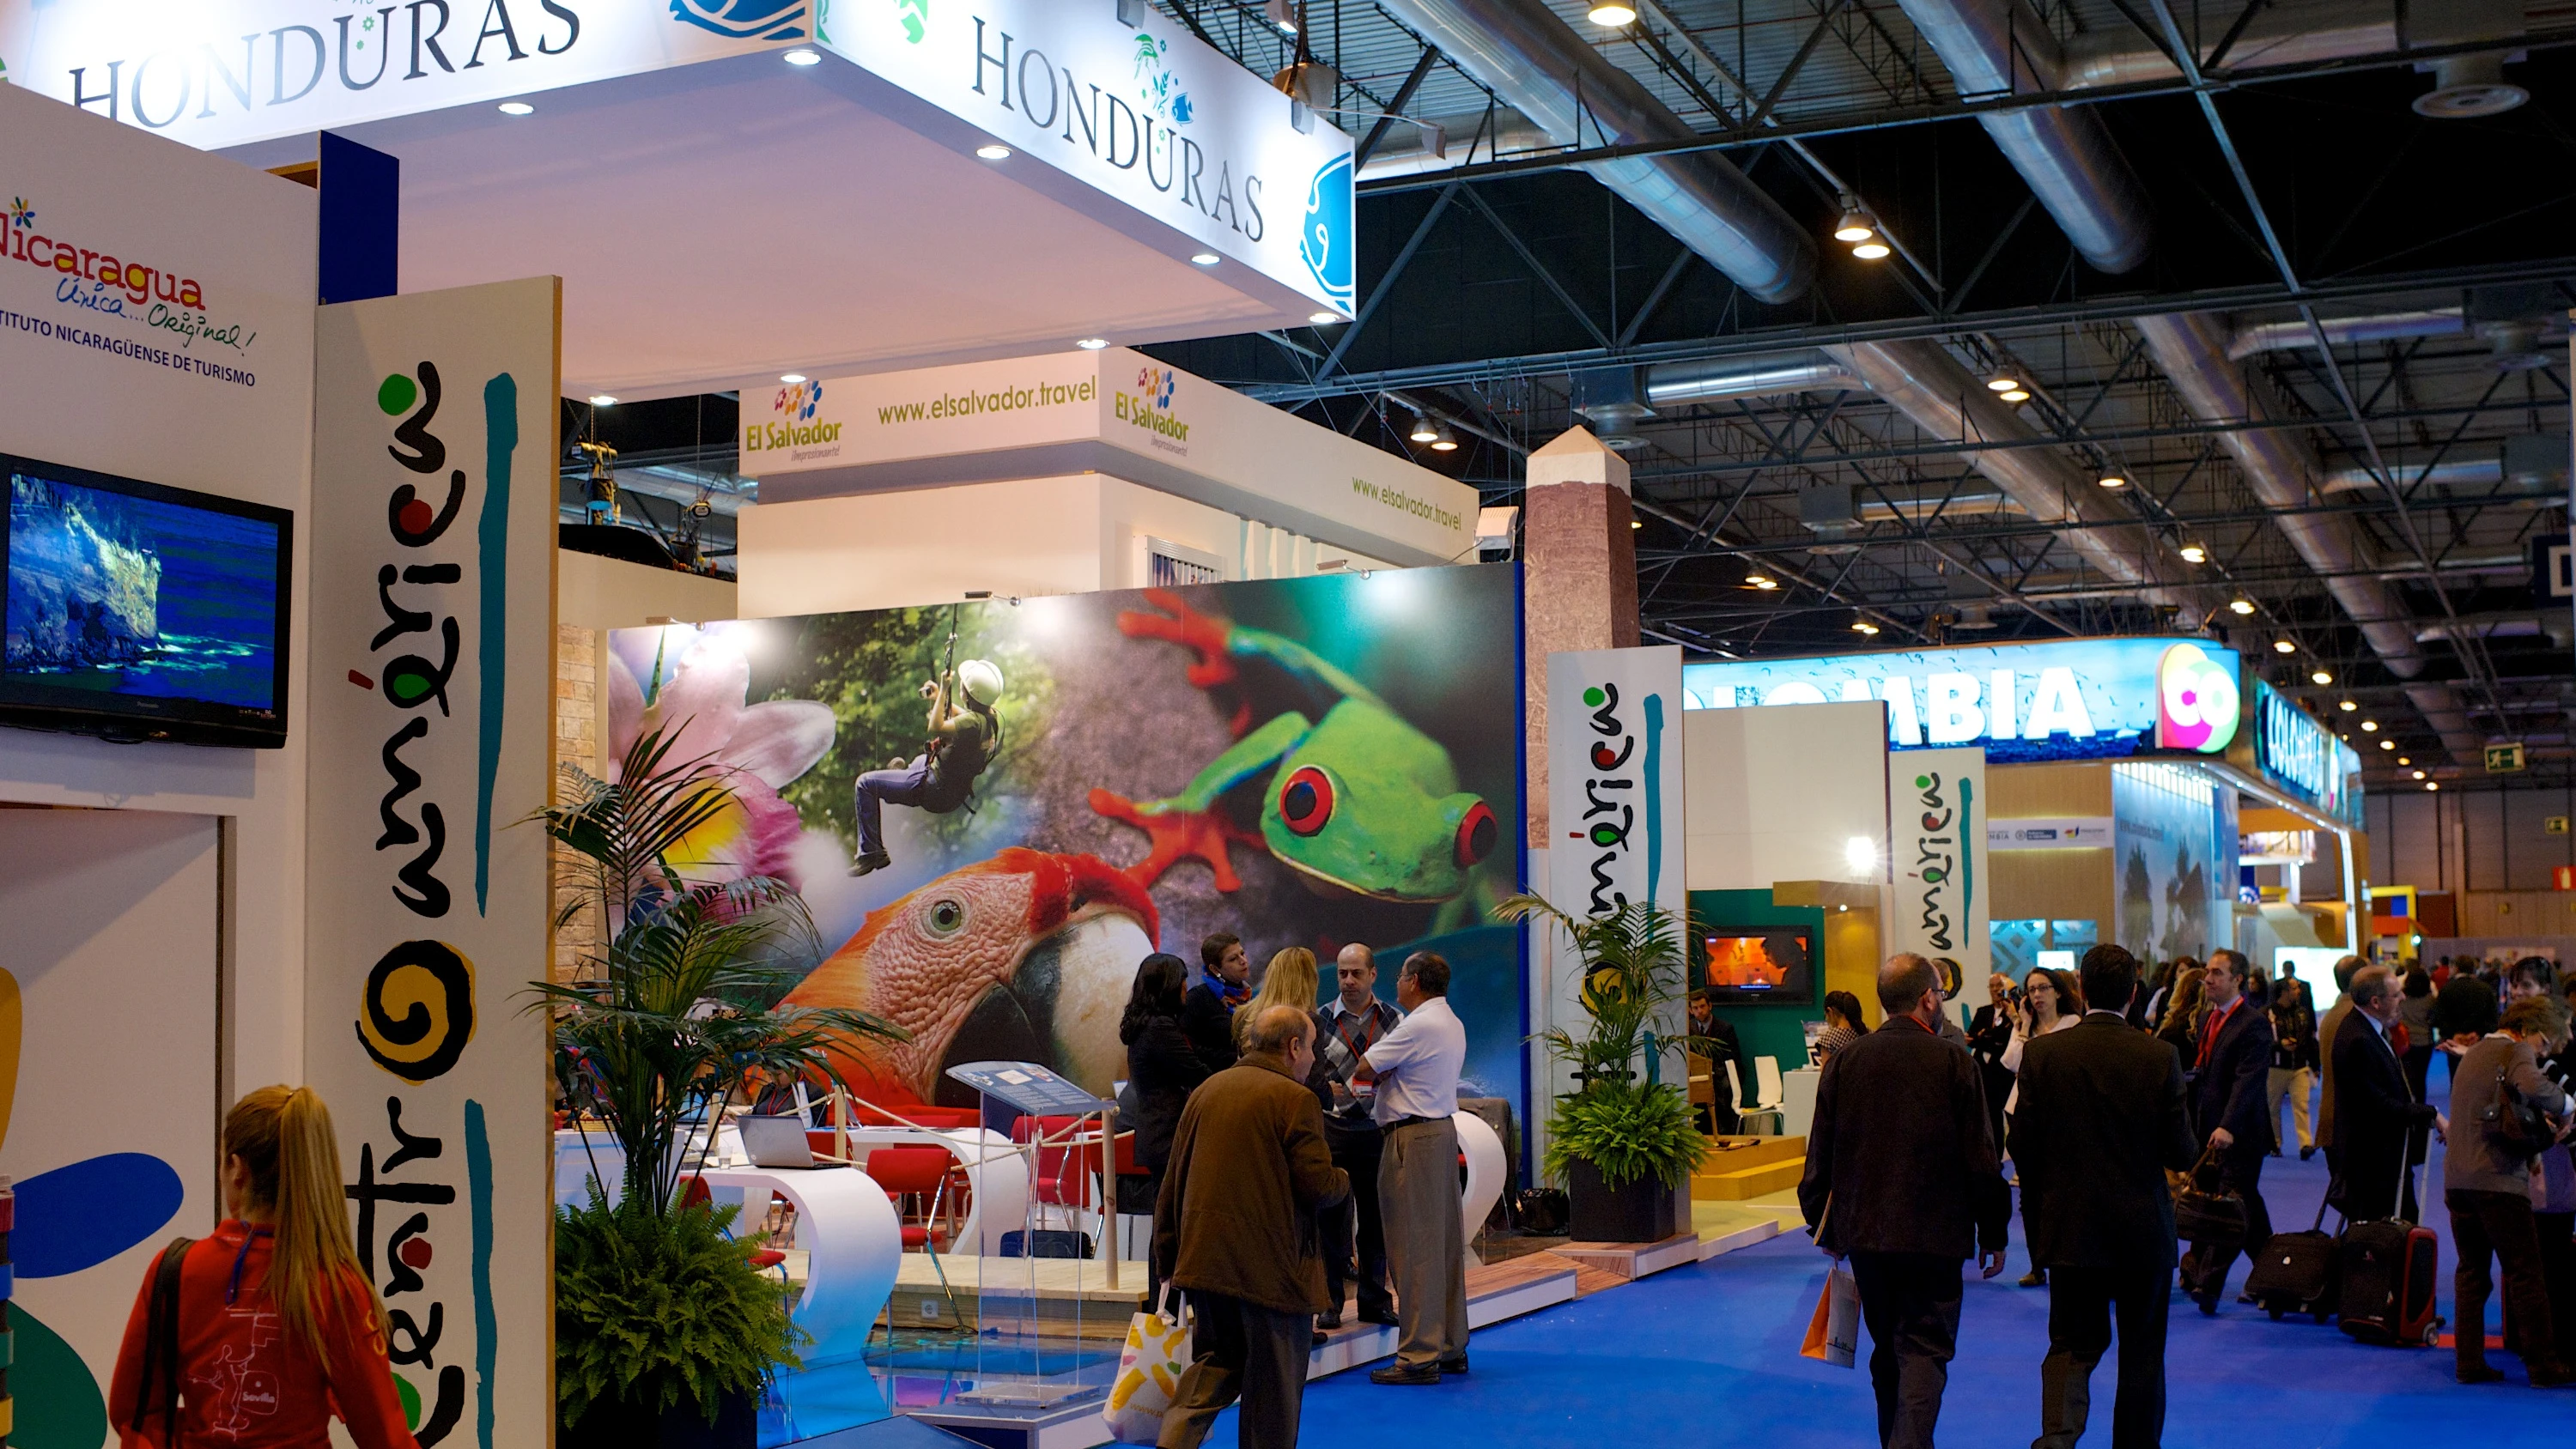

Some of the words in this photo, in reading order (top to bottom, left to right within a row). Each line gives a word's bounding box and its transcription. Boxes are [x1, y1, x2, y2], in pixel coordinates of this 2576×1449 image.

[68, 0, 580, 128] HONDURAS
[972, 15, 1264, 242] HONDURAS
[56, 324, 169, 367] NICARAGÜENSE
[173, 354, 191, 372] DE
[194, 359, 256, 387] TURISMO
[878, 375, 1096, 425] www.elsalvador.travel
[1115, 391, 1128, 421] El
[1131, 397, 1189, 442] Salvador
[746, 425, 762, 452] El
[766, 417, 842, 451] Salvador
[1352, 476, 1461, 530] www.elsalvador.travel
